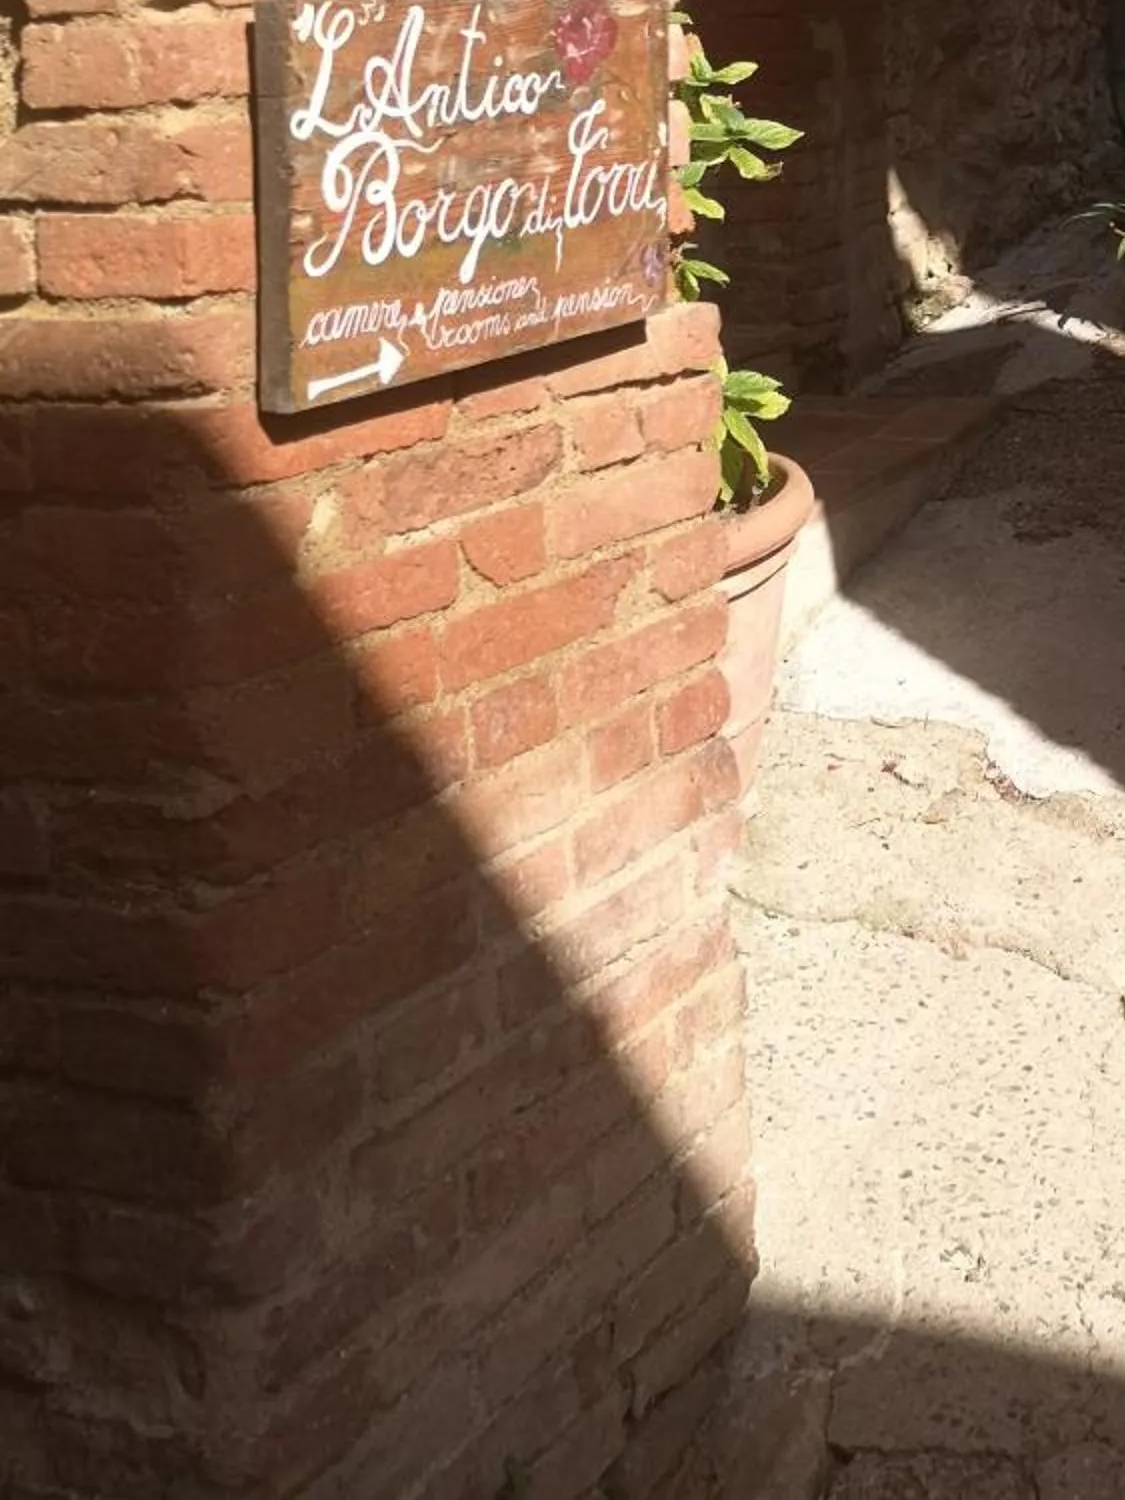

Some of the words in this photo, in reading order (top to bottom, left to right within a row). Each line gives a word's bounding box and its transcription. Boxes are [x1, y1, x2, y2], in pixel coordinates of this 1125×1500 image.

[304, 131, 533, 283] Borgo
[519, 176, 562, 250] di
[301, 300, 409, 348] camere
[436, 314, 511, 351] rooms
[513, 299, 552, 333] and
[548, 277, 660, 336] pension
